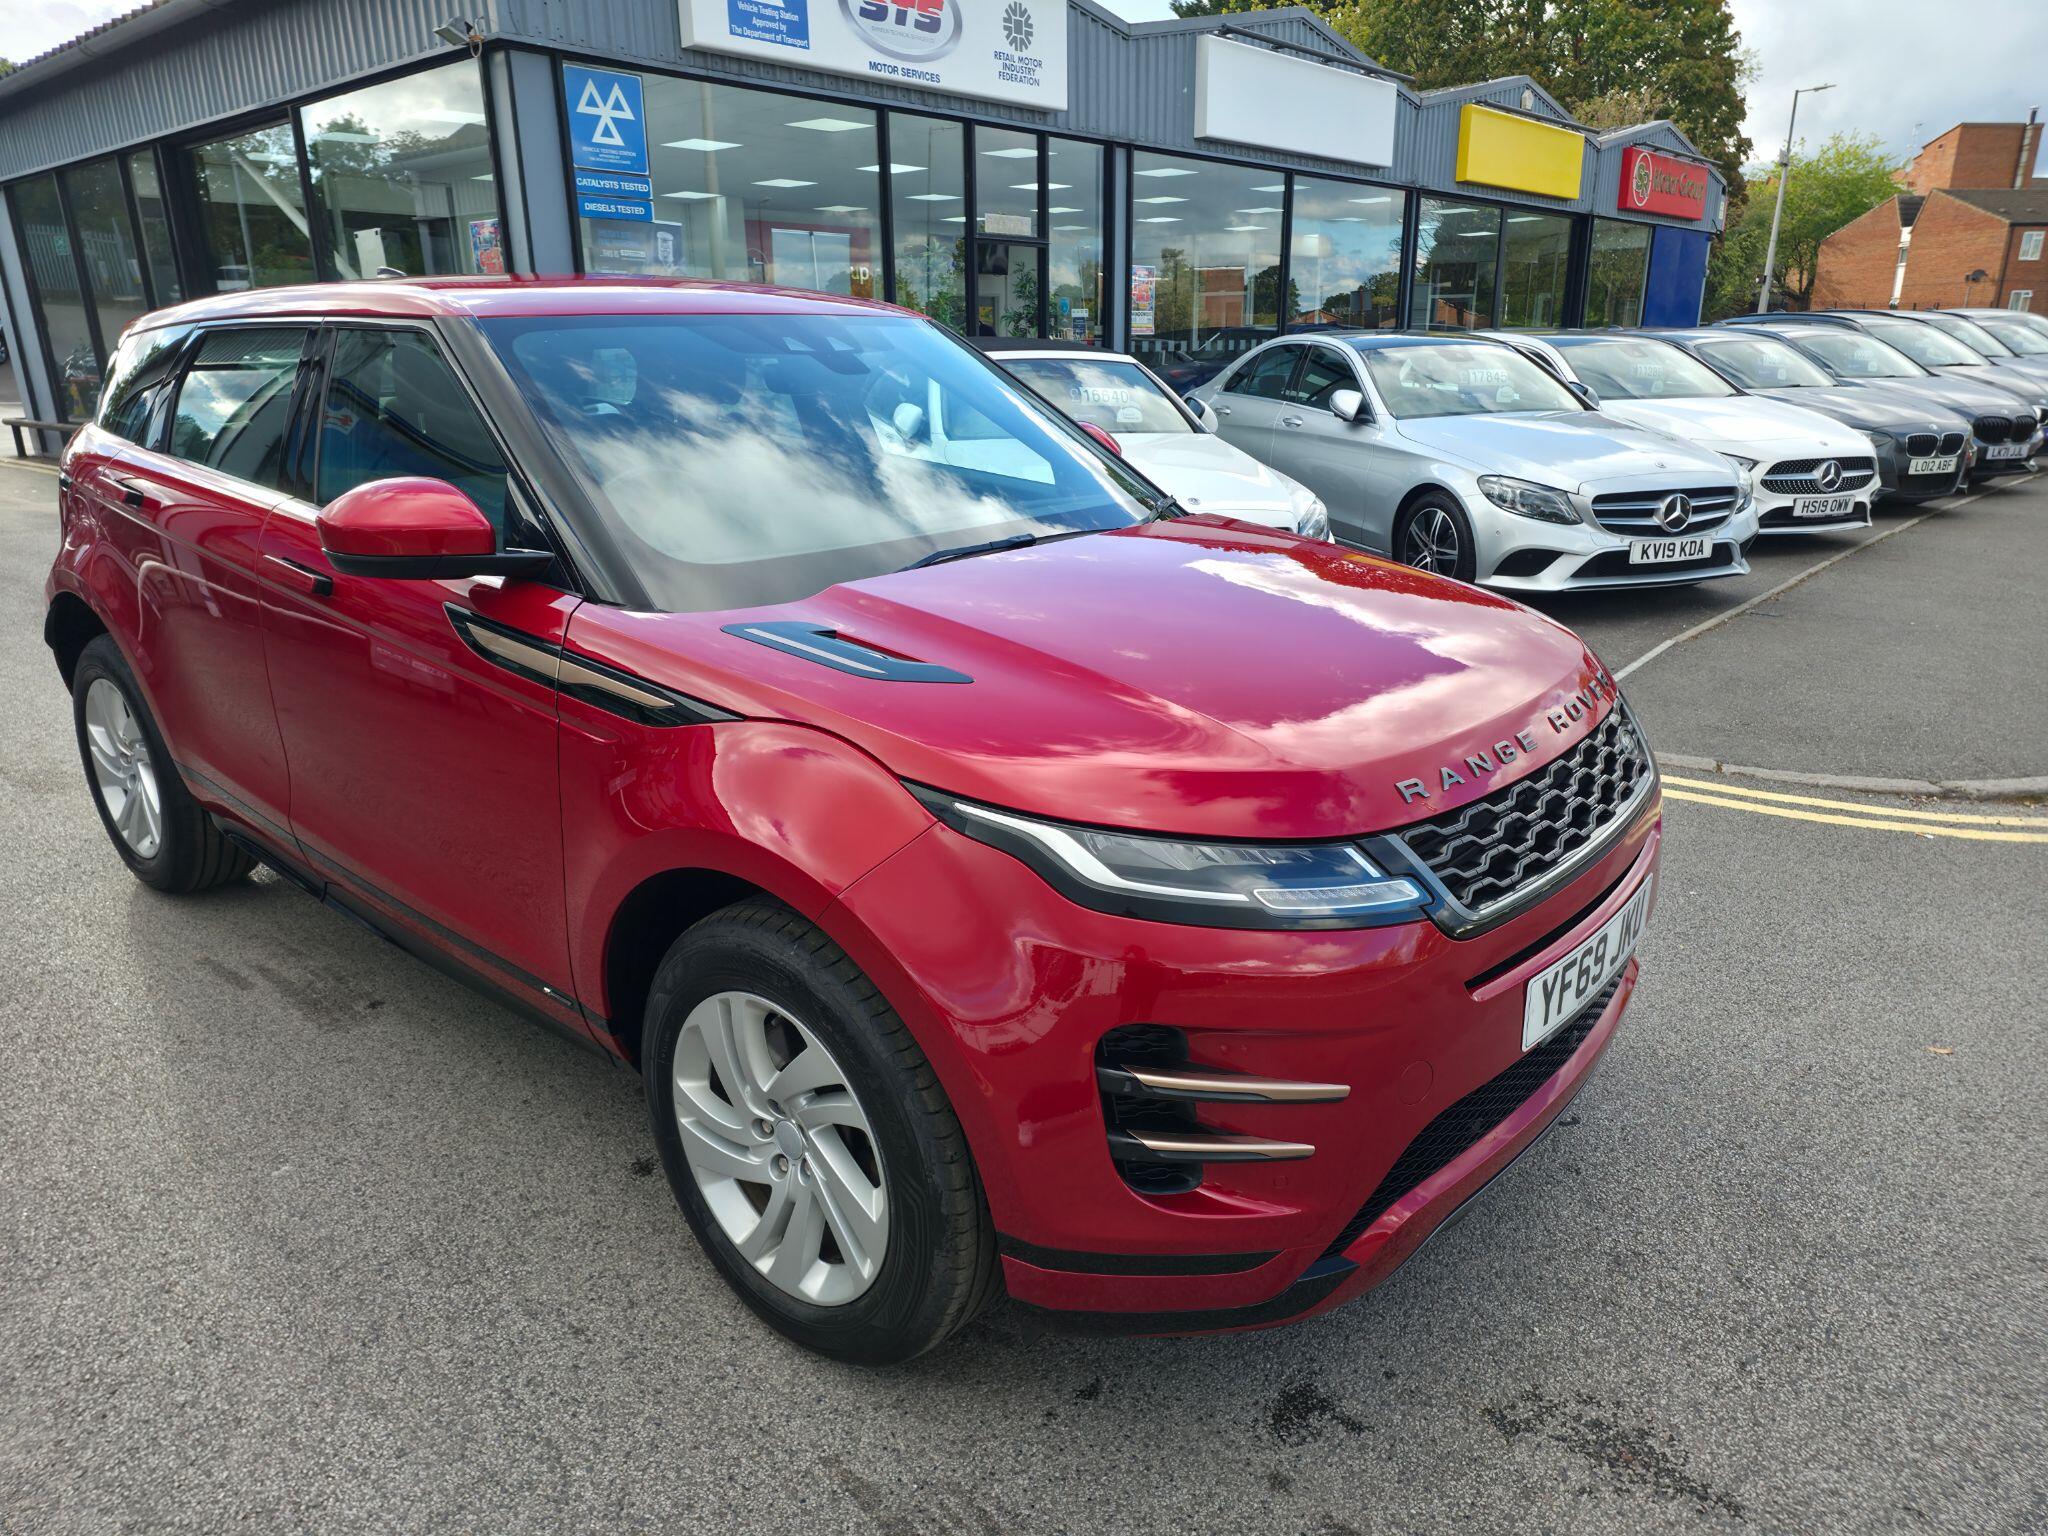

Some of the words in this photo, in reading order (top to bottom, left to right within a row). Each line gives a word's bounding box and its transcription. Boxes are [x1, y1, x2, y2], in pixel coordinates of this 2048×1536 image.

[737, 1, 758, 13] Vehicle
[758, 5, 779, 19] Testing
[780, 10, 799, 21] Station
[858, 0, 944, 33] STS
[752, 17, 779, 30] Approved
[780, 22, 787, 33] by
[731, 24, 742, 35] The
[743, 27, 775, 40] Department
[782, 35, 808, 47] Transport
[993, 50, 1016, 63] RETAIL
[1018, 56, 1043, 69] MOTOR
[1002, 62, 1037, 76] INDUSTRY
[868, 61, 899, 76] MOTOR
[901, 67, 941, 83] SERVICES
[998, 71, 1040, 87] FEDERATION
[576, 178, 619, 190] CATALYSTS
[620, 181, 649, 192] TESTED
[1653, 167, 1680, 196] Motor
[1680, 173, 1704, 201] Group
[584, 202, 616, 213] DIESELS
[617, 205, 645, 215] TESTED
[1914, 461, 1935, 473] LO12
[1936, 459, 1953, 471] ABF
[1801, 500, 1829, 514] HS19
[1830, 497, 1851, 513] OWW
[1641, 542, 1676, 560] KV19
[1679, 539, 1704, 557] KDA
[1395, 729, 1539, 803] RANGE
[1542, 932, 1608, 1027] YF69
[1610, 888, 1646, 967] JKU
